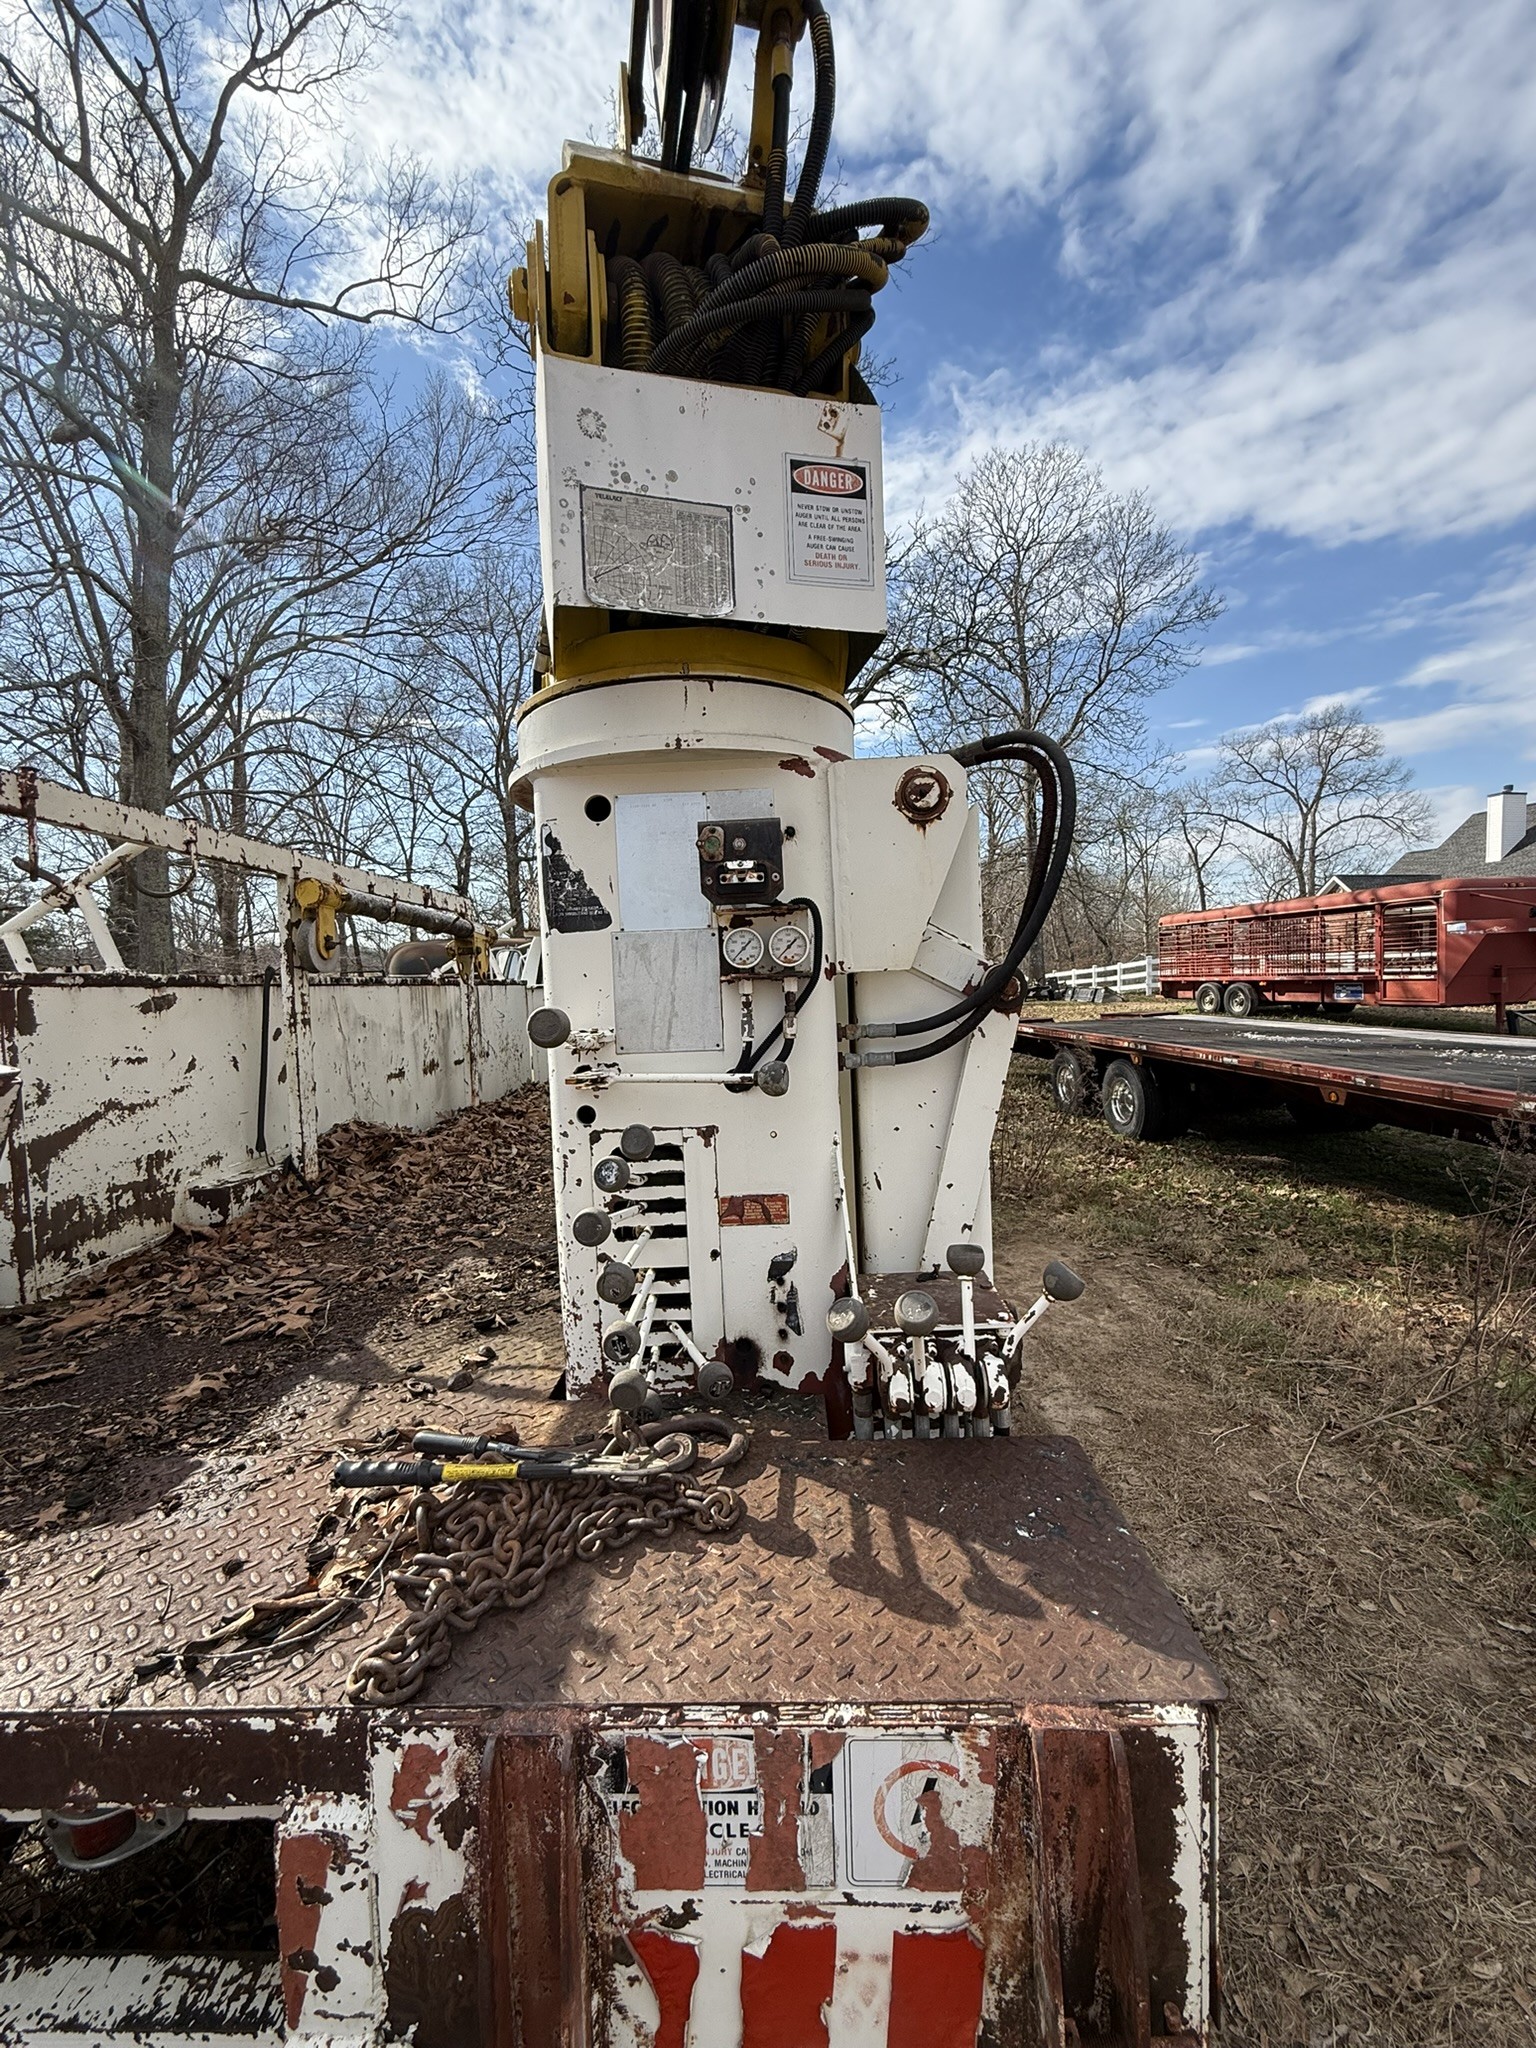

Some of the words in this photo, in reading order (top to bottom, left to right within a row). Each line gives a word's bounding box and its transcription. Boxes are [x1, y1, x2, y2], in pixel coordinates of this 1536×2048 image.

[804, 469, 853, 490] DANGER
[797, 503, 814, 511] NEVER
[816, 504, 831, 512] STOW
[814, 513, 829, 521] UNTIL
[842, 516, 865, 524] PERSONS
[798, 520, 808, 528] ARE
[810, 521, 826, 529] CLEAR
[813, 535, 854, 544] FREE-SWINGING
[806, 542, 824, 550] AUGER
[838, 545, 855, 553] CAUSE
[815, 552, 837, 560] DEATH
[804, 559, 833, 568] SERIOUS
[834, 562, 861, 570] INJURY.
[735, 1847, 749, 1856] CA
[714, 1858, 748, 1868] MACHIN
